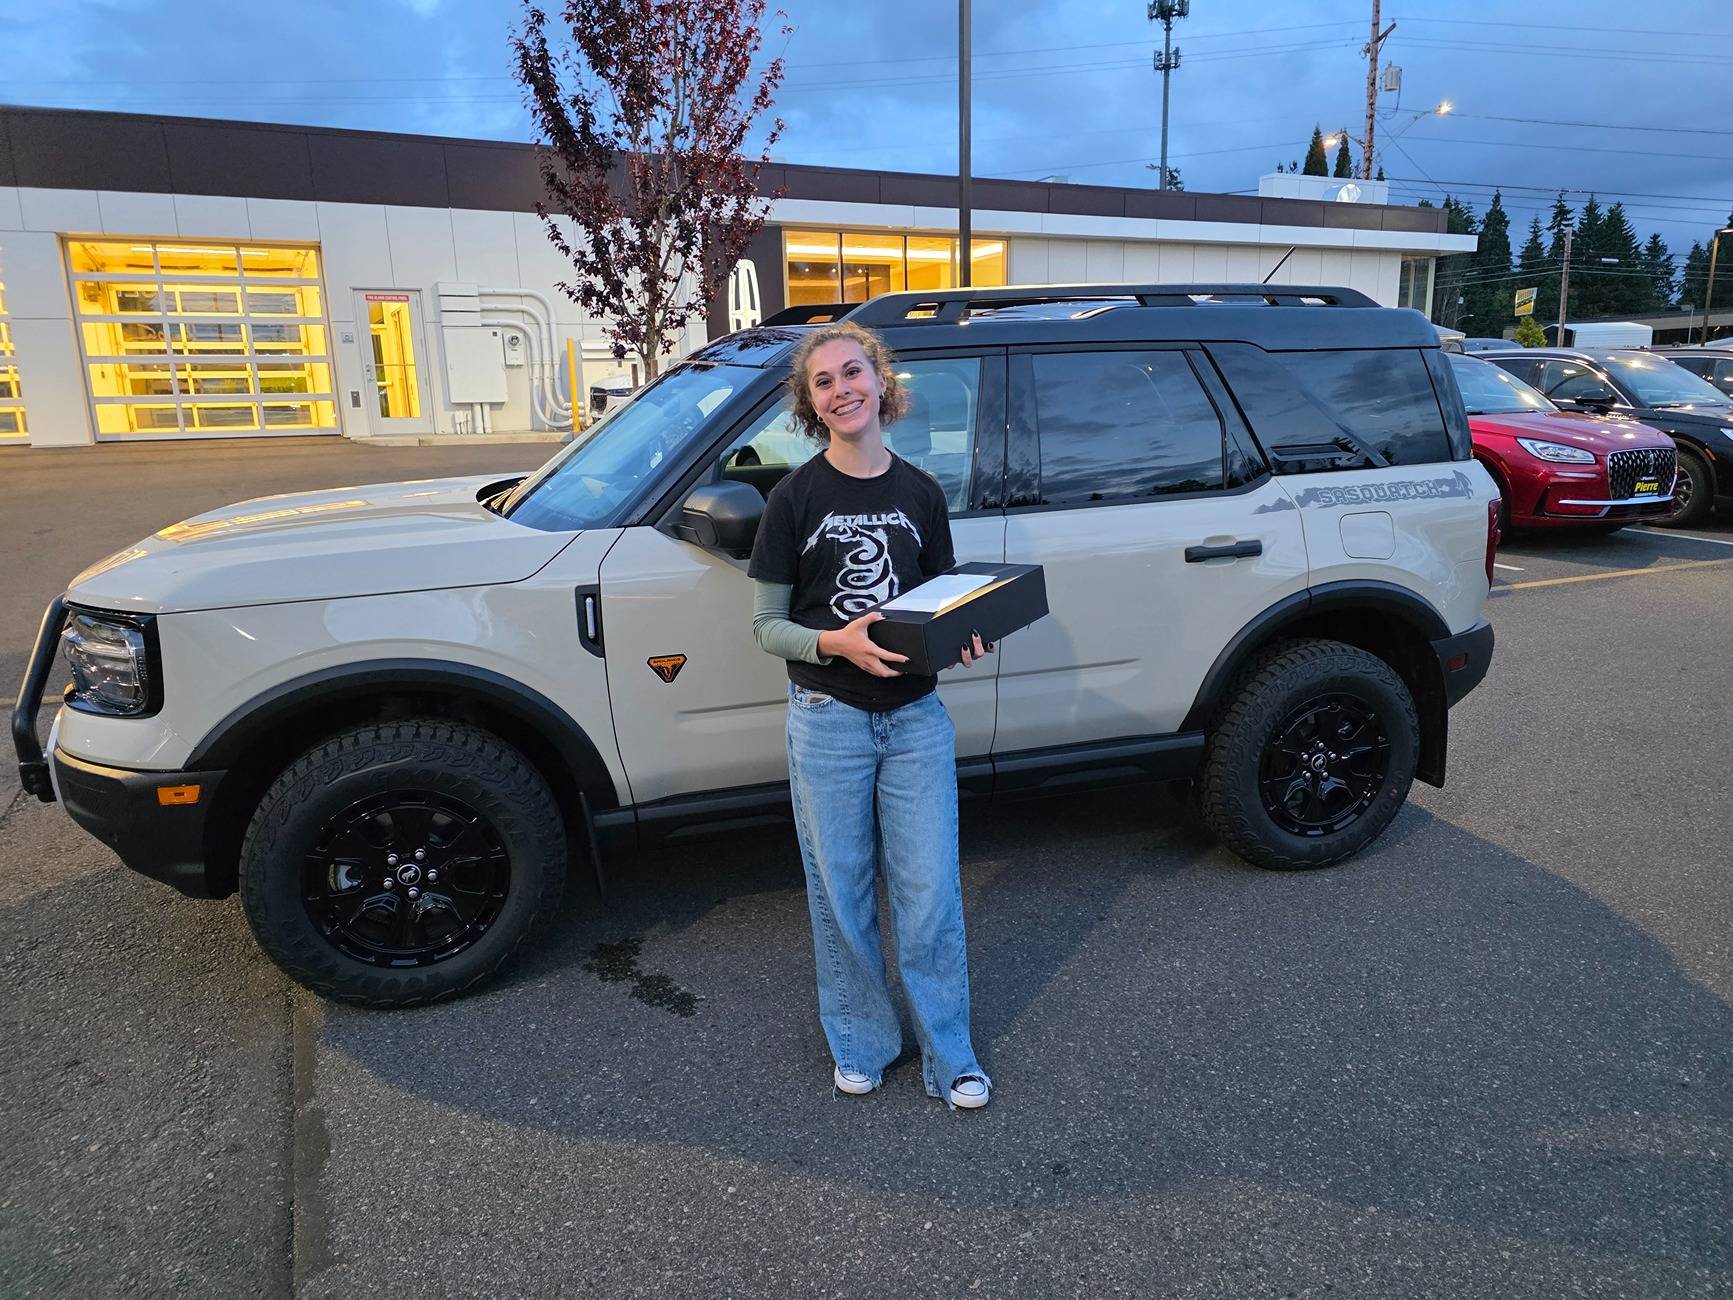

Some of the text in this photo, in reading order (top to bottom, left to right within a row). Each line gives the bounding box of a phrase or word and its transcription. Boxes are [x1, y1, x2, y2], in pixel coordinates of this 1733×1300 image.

[1318, 480, 1441, 504] SASQUATCH
[1634, 481, 1659, 492] Pierre
[801, 506, 922, 556] METALLICA
